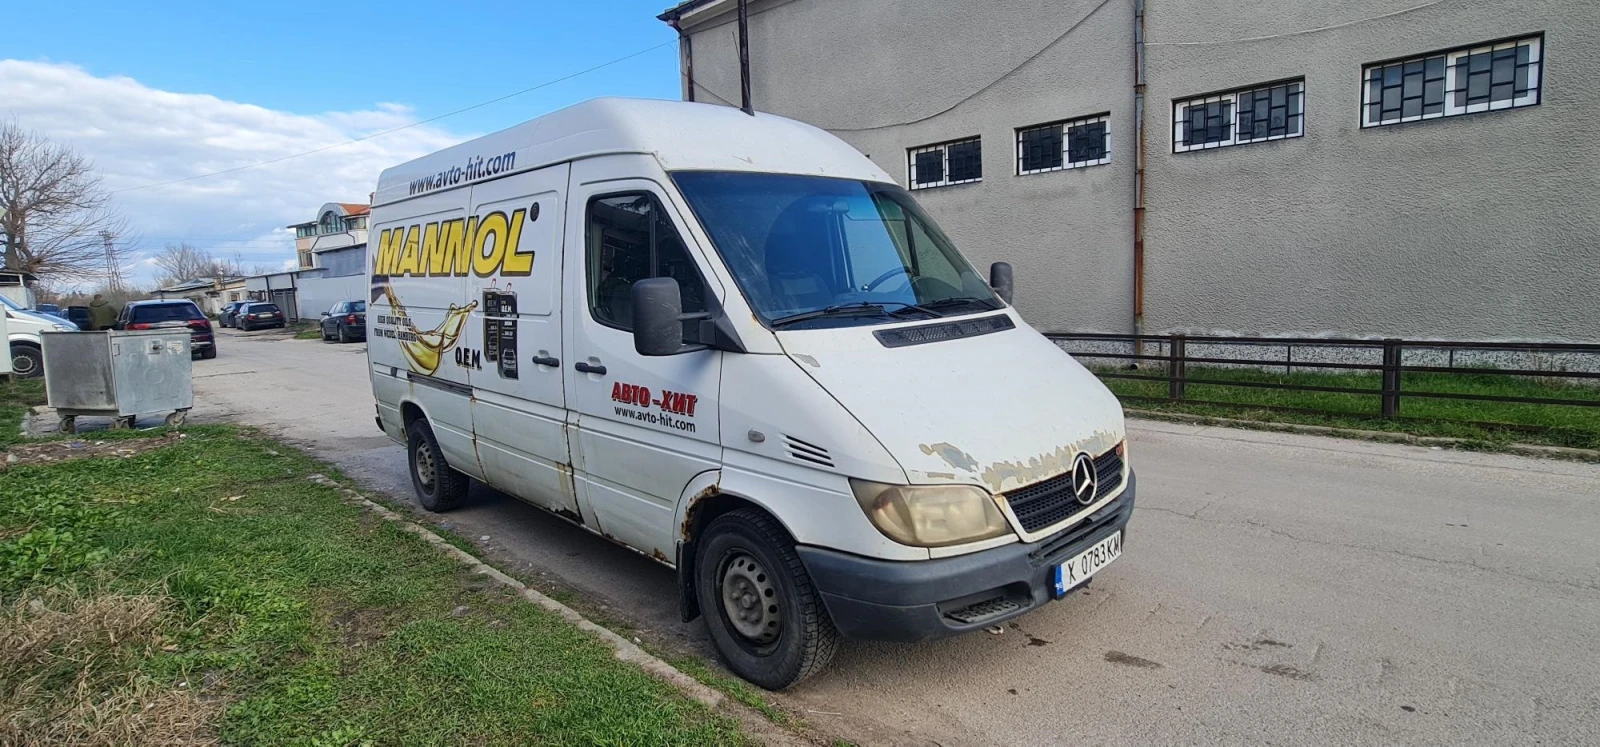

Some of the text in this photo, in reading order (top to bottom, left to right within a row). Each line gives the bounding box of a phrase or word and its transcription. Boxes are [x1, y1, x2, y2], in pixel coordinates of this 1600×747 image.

[409, 151, 516, 195] www.avto-hit.com
[375, 208, 535, 278] MANNOL
[614, 406, 696, 433] www.avto-hit.com
